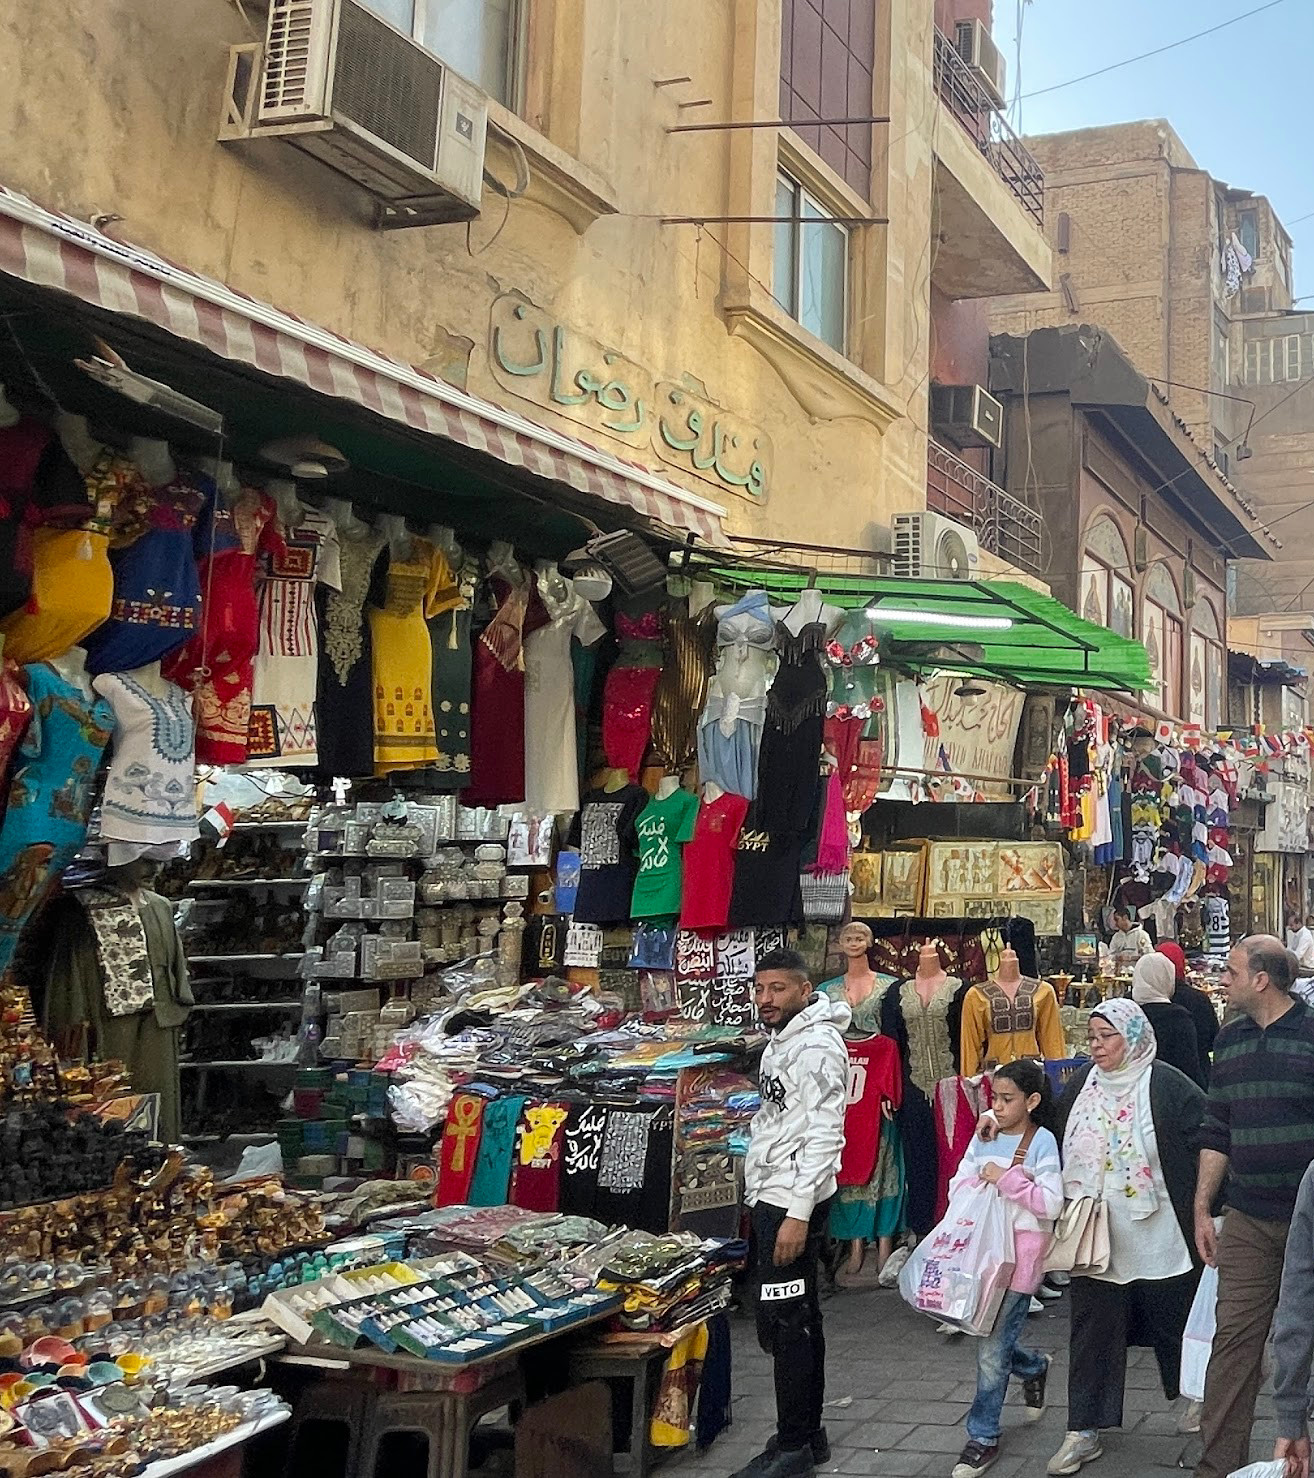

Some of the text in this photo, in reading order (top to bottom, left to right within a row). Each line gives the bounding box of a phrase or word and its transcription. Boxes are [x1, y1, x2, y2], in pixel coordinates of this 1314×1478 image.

[493, 304, 766, 496] فندق رضوان
[738, 841, 769, 852] GYPT
[1212, 915, 1220, 931] 8
[849, 1056, 869, 1065] ALAH
[652, 1120, 674, 1131] YPT
[764, 1284, 800, 1297] VETO
